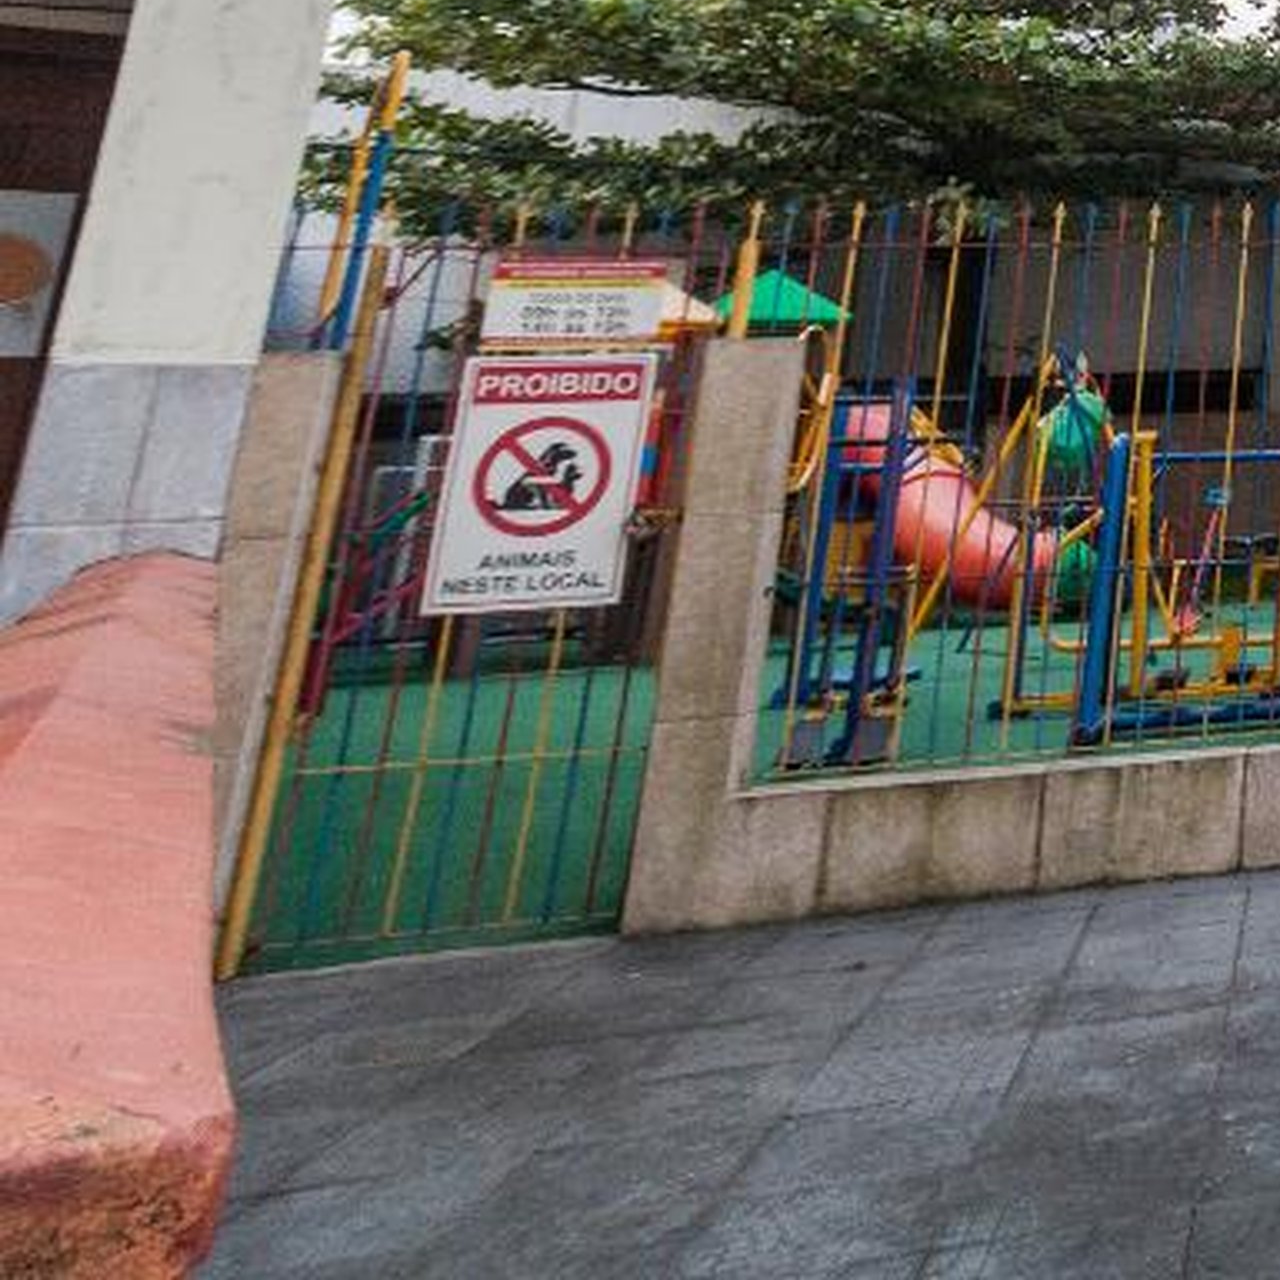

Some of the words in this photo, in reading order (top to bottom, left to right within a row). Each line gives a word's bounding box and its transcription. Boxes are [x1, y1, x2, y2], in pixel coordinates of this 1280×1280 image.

[477, 371, 639, 399] PROIBIDO
[478, 548, 577, 570] ANIMAIS
[441, 575, 523, 596] NESTE
[525, 570, 606, 591] LOCAL
